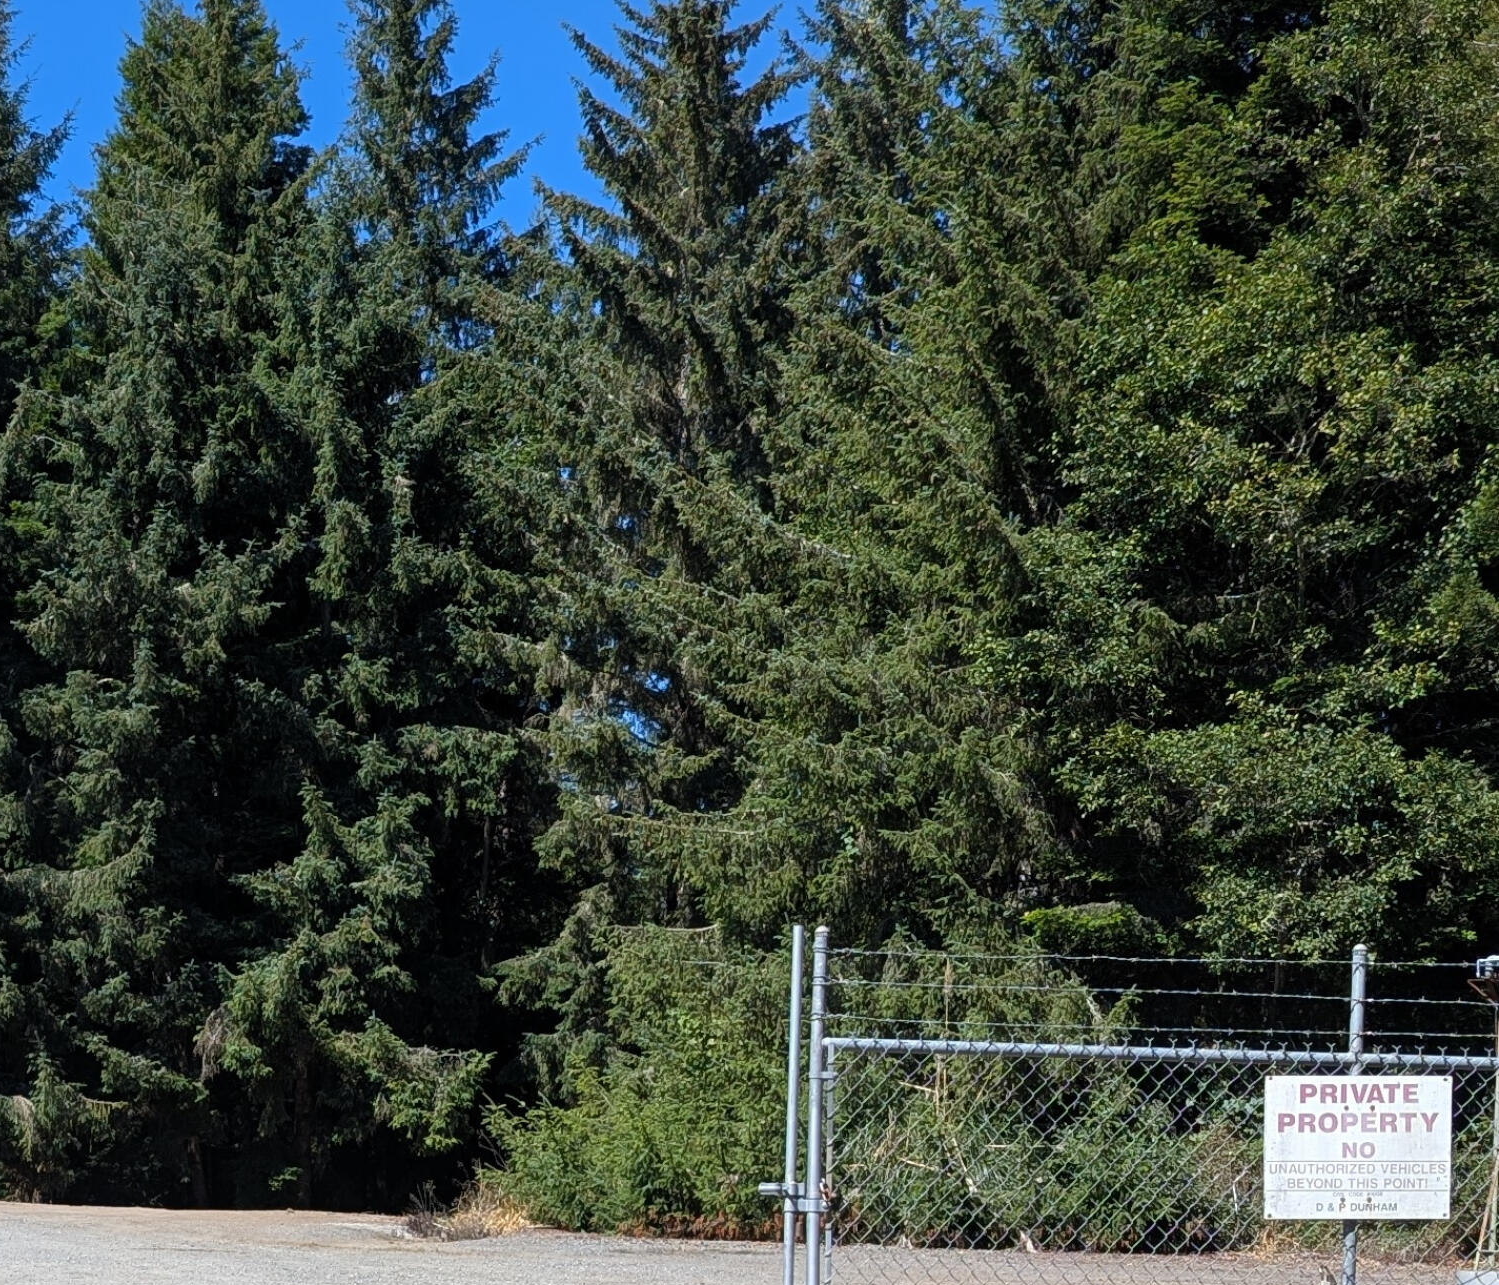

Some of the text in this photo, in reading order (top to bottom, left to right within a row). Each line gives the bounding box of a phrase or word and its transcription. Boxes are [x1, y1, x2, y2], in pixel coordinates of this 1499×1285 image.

[1300, 1084, 1418, 1103] PRIVATE
[1278, 1113, 1438, 1133] PROPERTY
[1342, 1142, 1375, 1158] NO
[1270, 1163, 1446, 1174] UNAUTHORIZED VEHICLES
[1287, 1178, 1428, 1189] BEYOND THIS POINT!
[1316, 1203, 1323, 1211] D
[1328, 1203, 1334, 1212] &
[1351, 1203, 1397, 1212] DUNHAM
